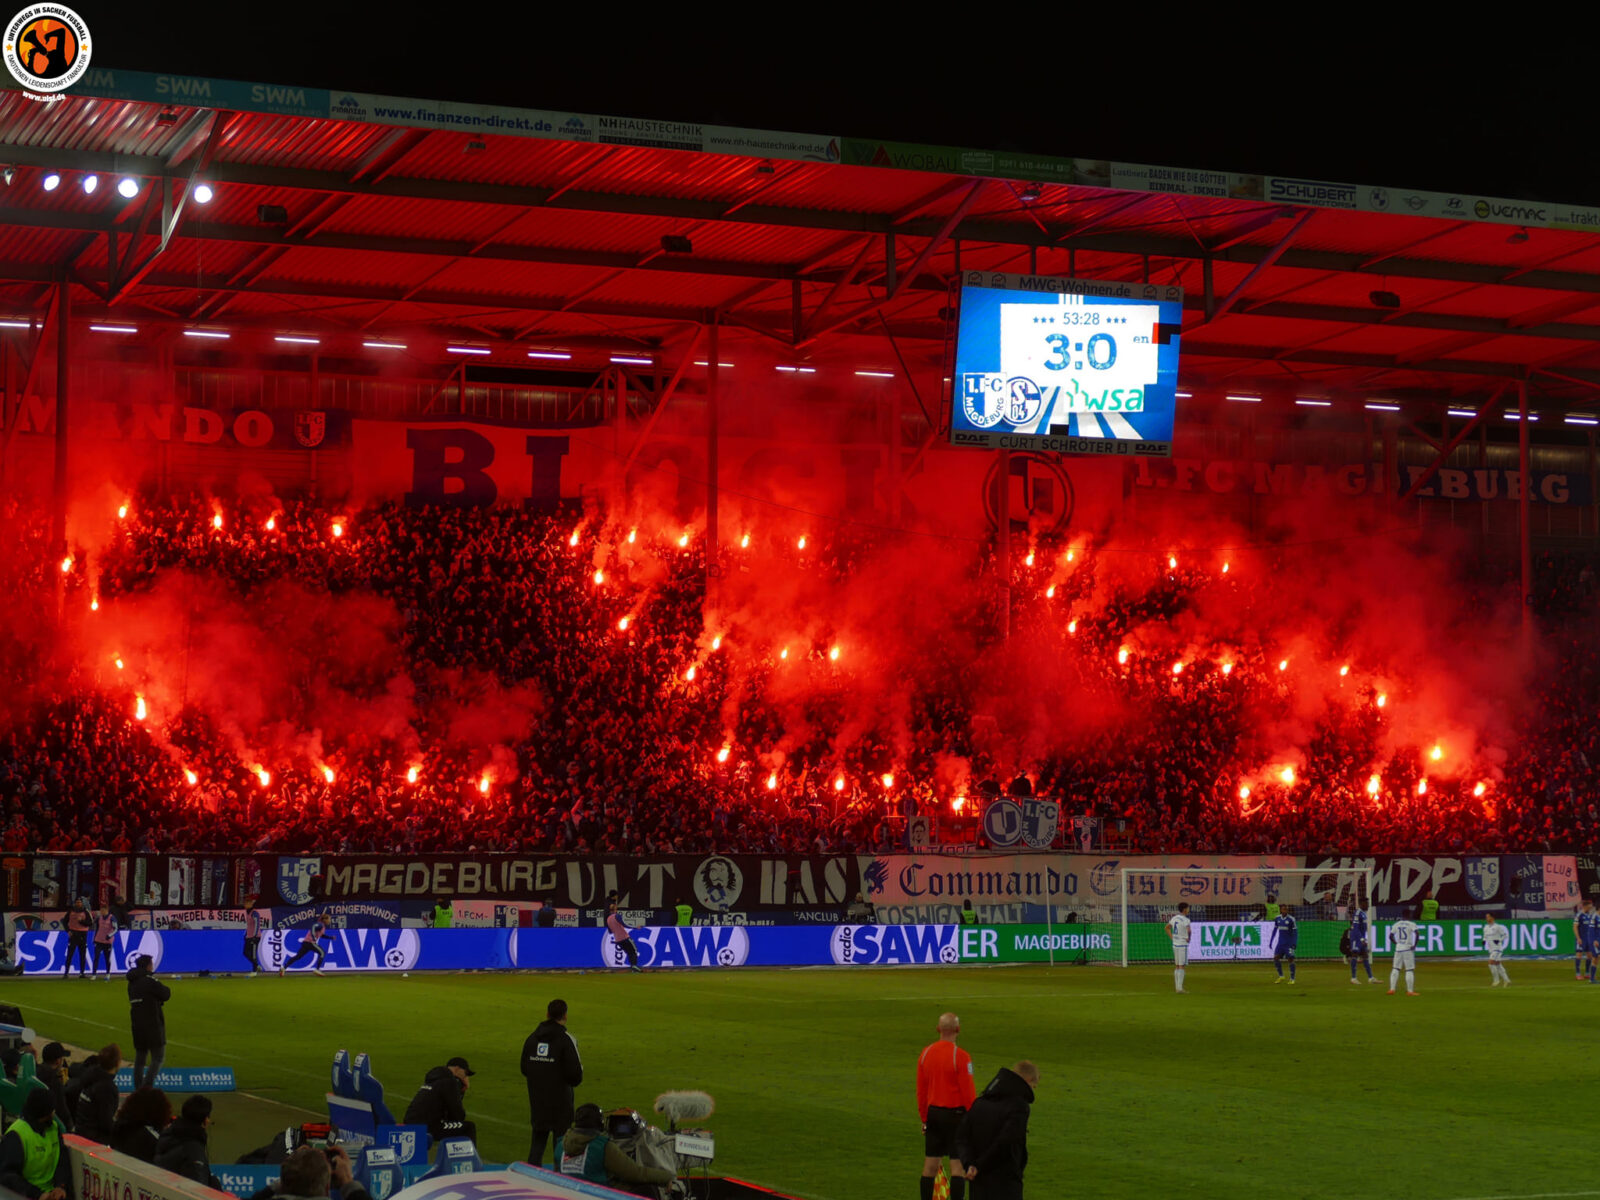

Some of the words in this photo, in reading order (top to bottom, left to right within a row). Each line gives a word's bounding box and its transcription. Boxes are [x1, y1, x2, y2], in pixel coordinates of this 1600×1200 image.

[154, 76, 211, 97] SWM
[250, 84, 306, 107] SWM
[374, 107, 552, 132] www.finanzen-direkt.de
[710, 136, 825, 154] www.nh-haustechnik-md.de
[894, 152, 957, 171] WOBAU
[1148, 168, 1171, 180] BADEN
[1172, 171, 1186, 182] WIE
[1148, 182, 1186, 193] EINMAL
[1192, 186, 1226, 197] IMMER
[1270, 179, 1355, 201] SCHUBERT
[1019, 277, 1131, 297] MWG-Wohnen.de
[1062, 312, 1100, 326] 53:28
[1043, 333, 1118, 371] 3:0
[966, 377, 1003, 394] 1.FC
[965, 396, 1005, 426] MAGDEBURG
[954, 433, 990, 442] DAF
[999, 436, 1036, 449] CURT
[1041, 437, 1113, 454] SCHRÖTER
[1134, 443, 1169, 452] DAF
[1024, 800, 1057, 820] 1.FC
[279, 862, 317, 877] 1.FC
[325, 859, 557, 896] MAGDEBURG
[1466, 862, 1496, 876] 1.FC
[1546, 863, 1572, 878] CLUB
[899, 863, 1077, 897] Commando
[1523, 892, 1566, 904] REFORM
[277, 908, 321, 930] STENDAL
[1014, 934, 1112, 950] MAGDEBURG
[1397, 926, 1406, 940] 15
[270, 928, 282, 968] radio
[838, 926, 852, 963] radio
[852, 926, 955, 964] SAW
[1201, 948, 1261, 956] VERSICHERUNG
[189, 1072, 231, 1082] mhkw
[391, 1133, 413, 1144] 1.FC
